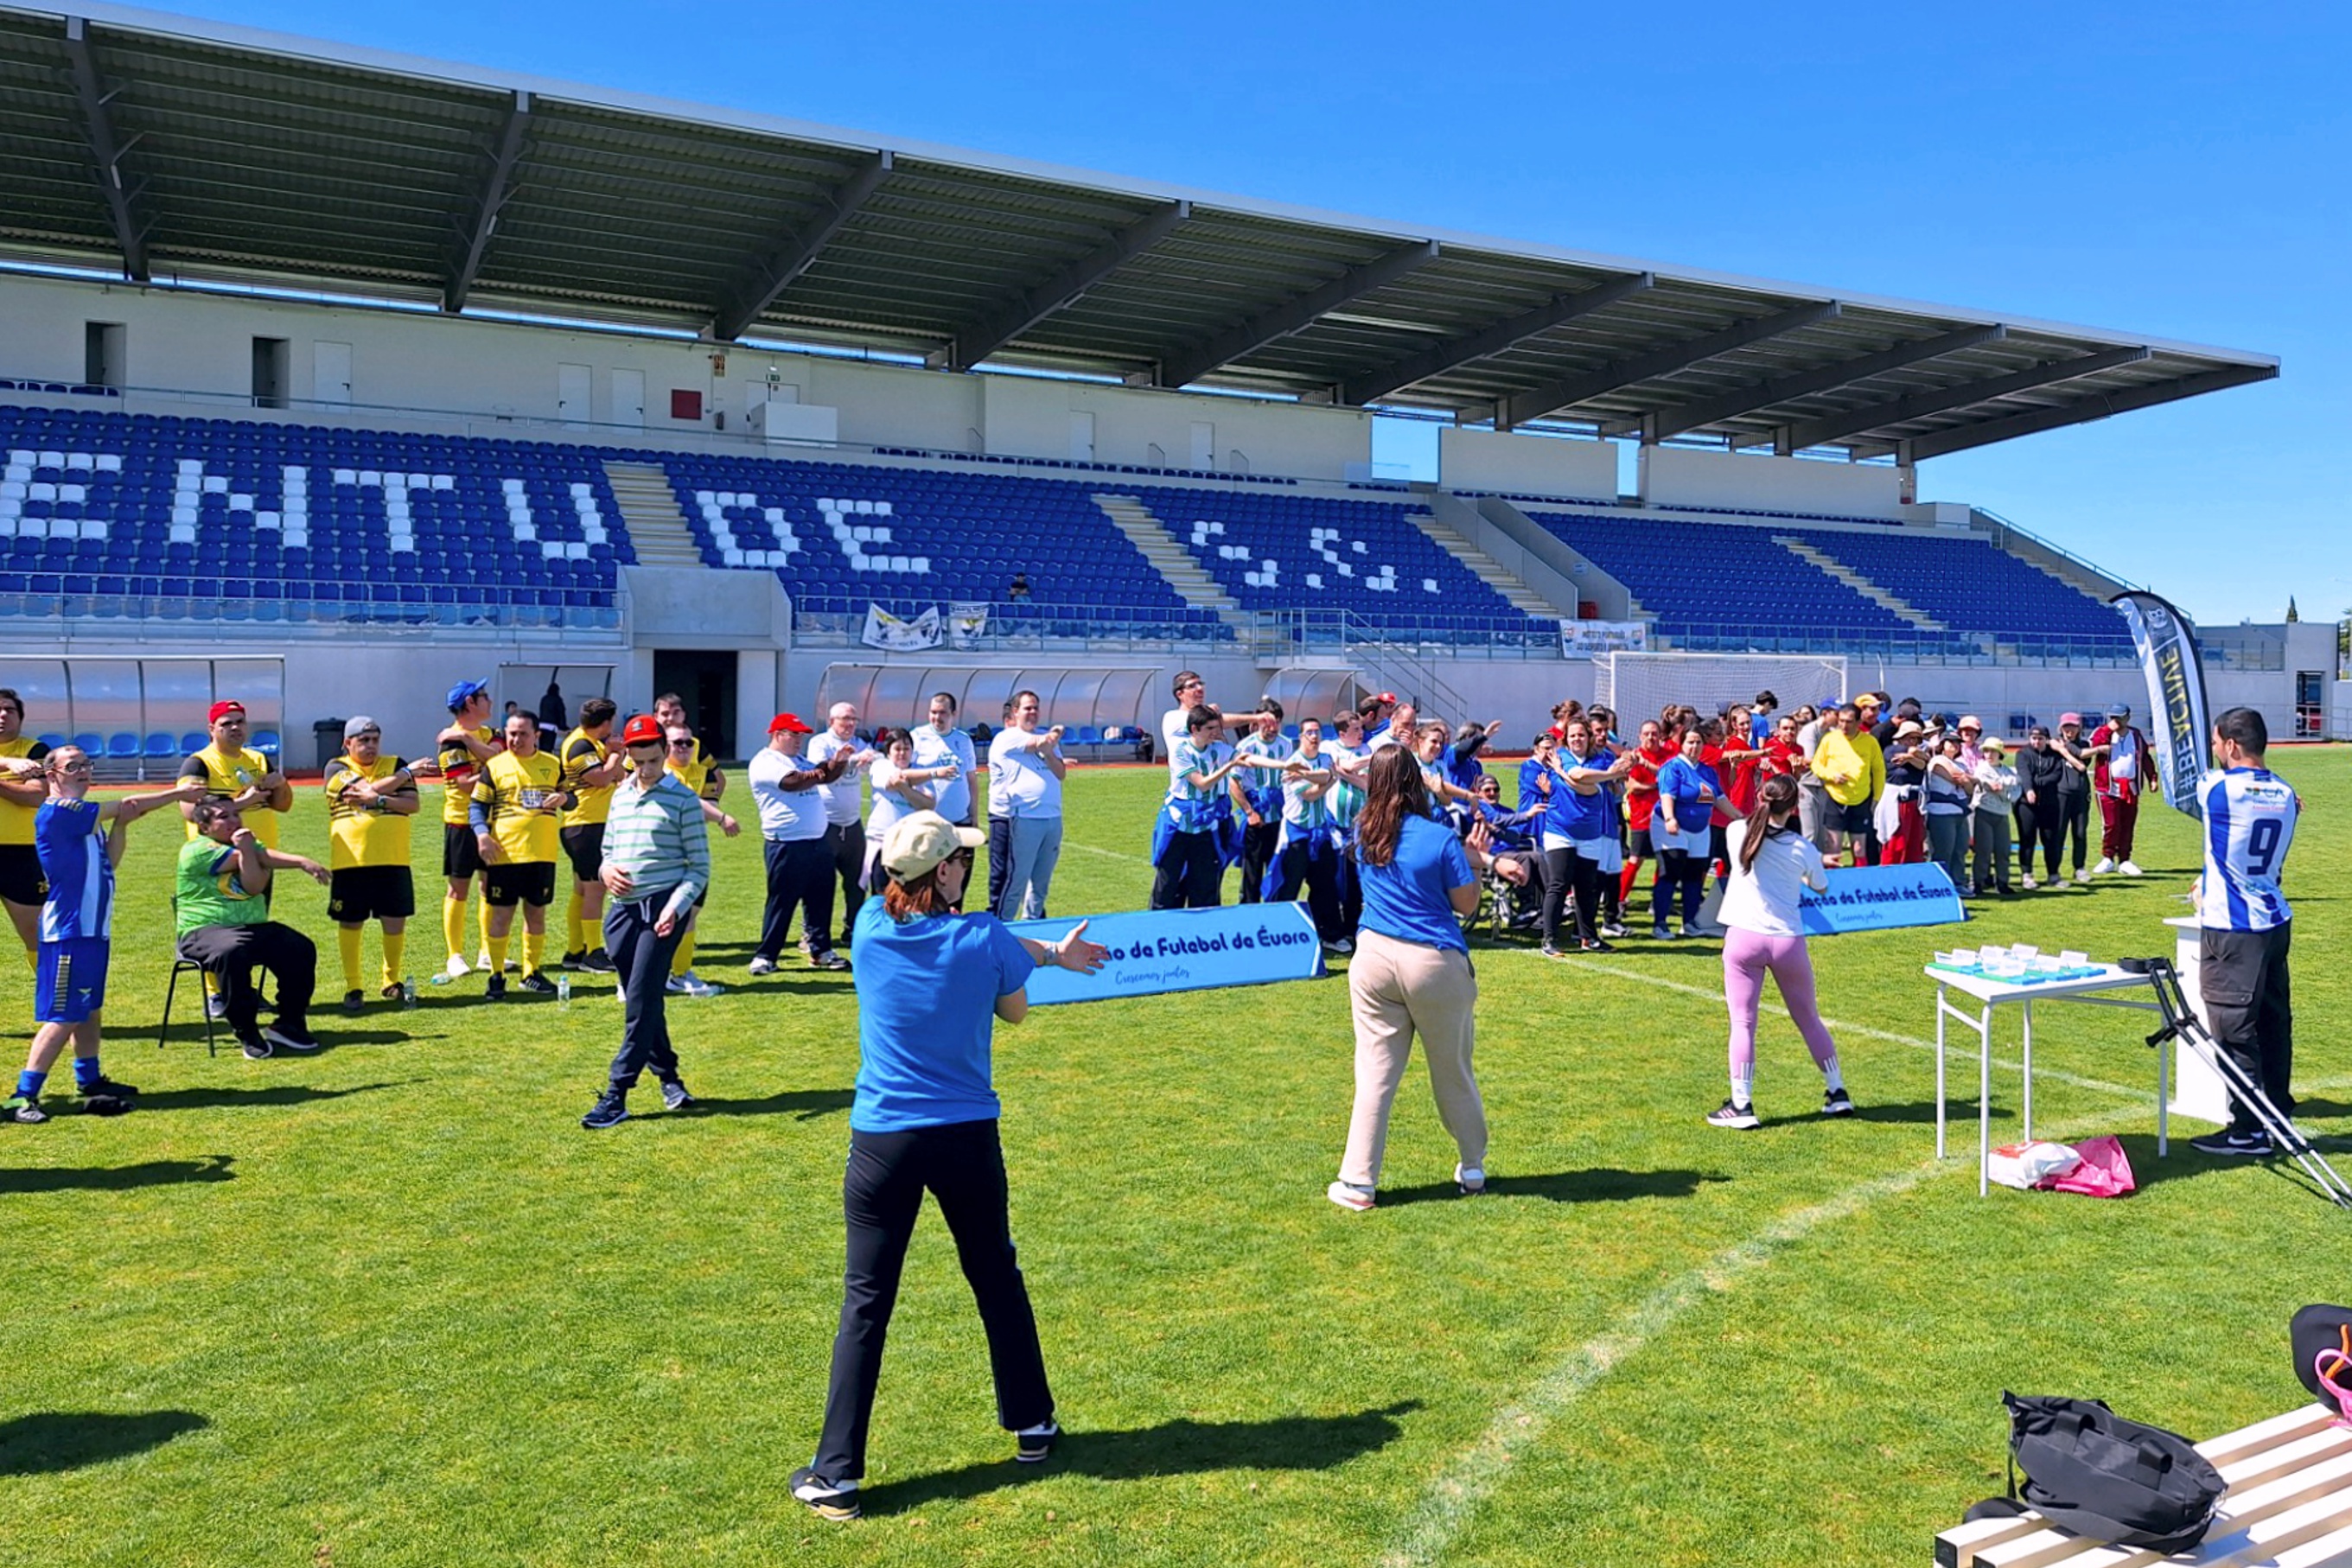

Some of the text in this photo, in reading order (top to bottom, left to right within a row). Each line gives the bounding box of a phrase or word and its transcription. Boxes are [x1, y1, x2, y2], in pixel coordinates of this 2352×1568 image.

[2247, 819, 2283, 876] 9
[1130, 940, 1154, 959] de
[1157, 932, 1229, 957] Futebol
[1232, 930, 1254, 951] de
[1256, 924, 1311, 948] Évora
